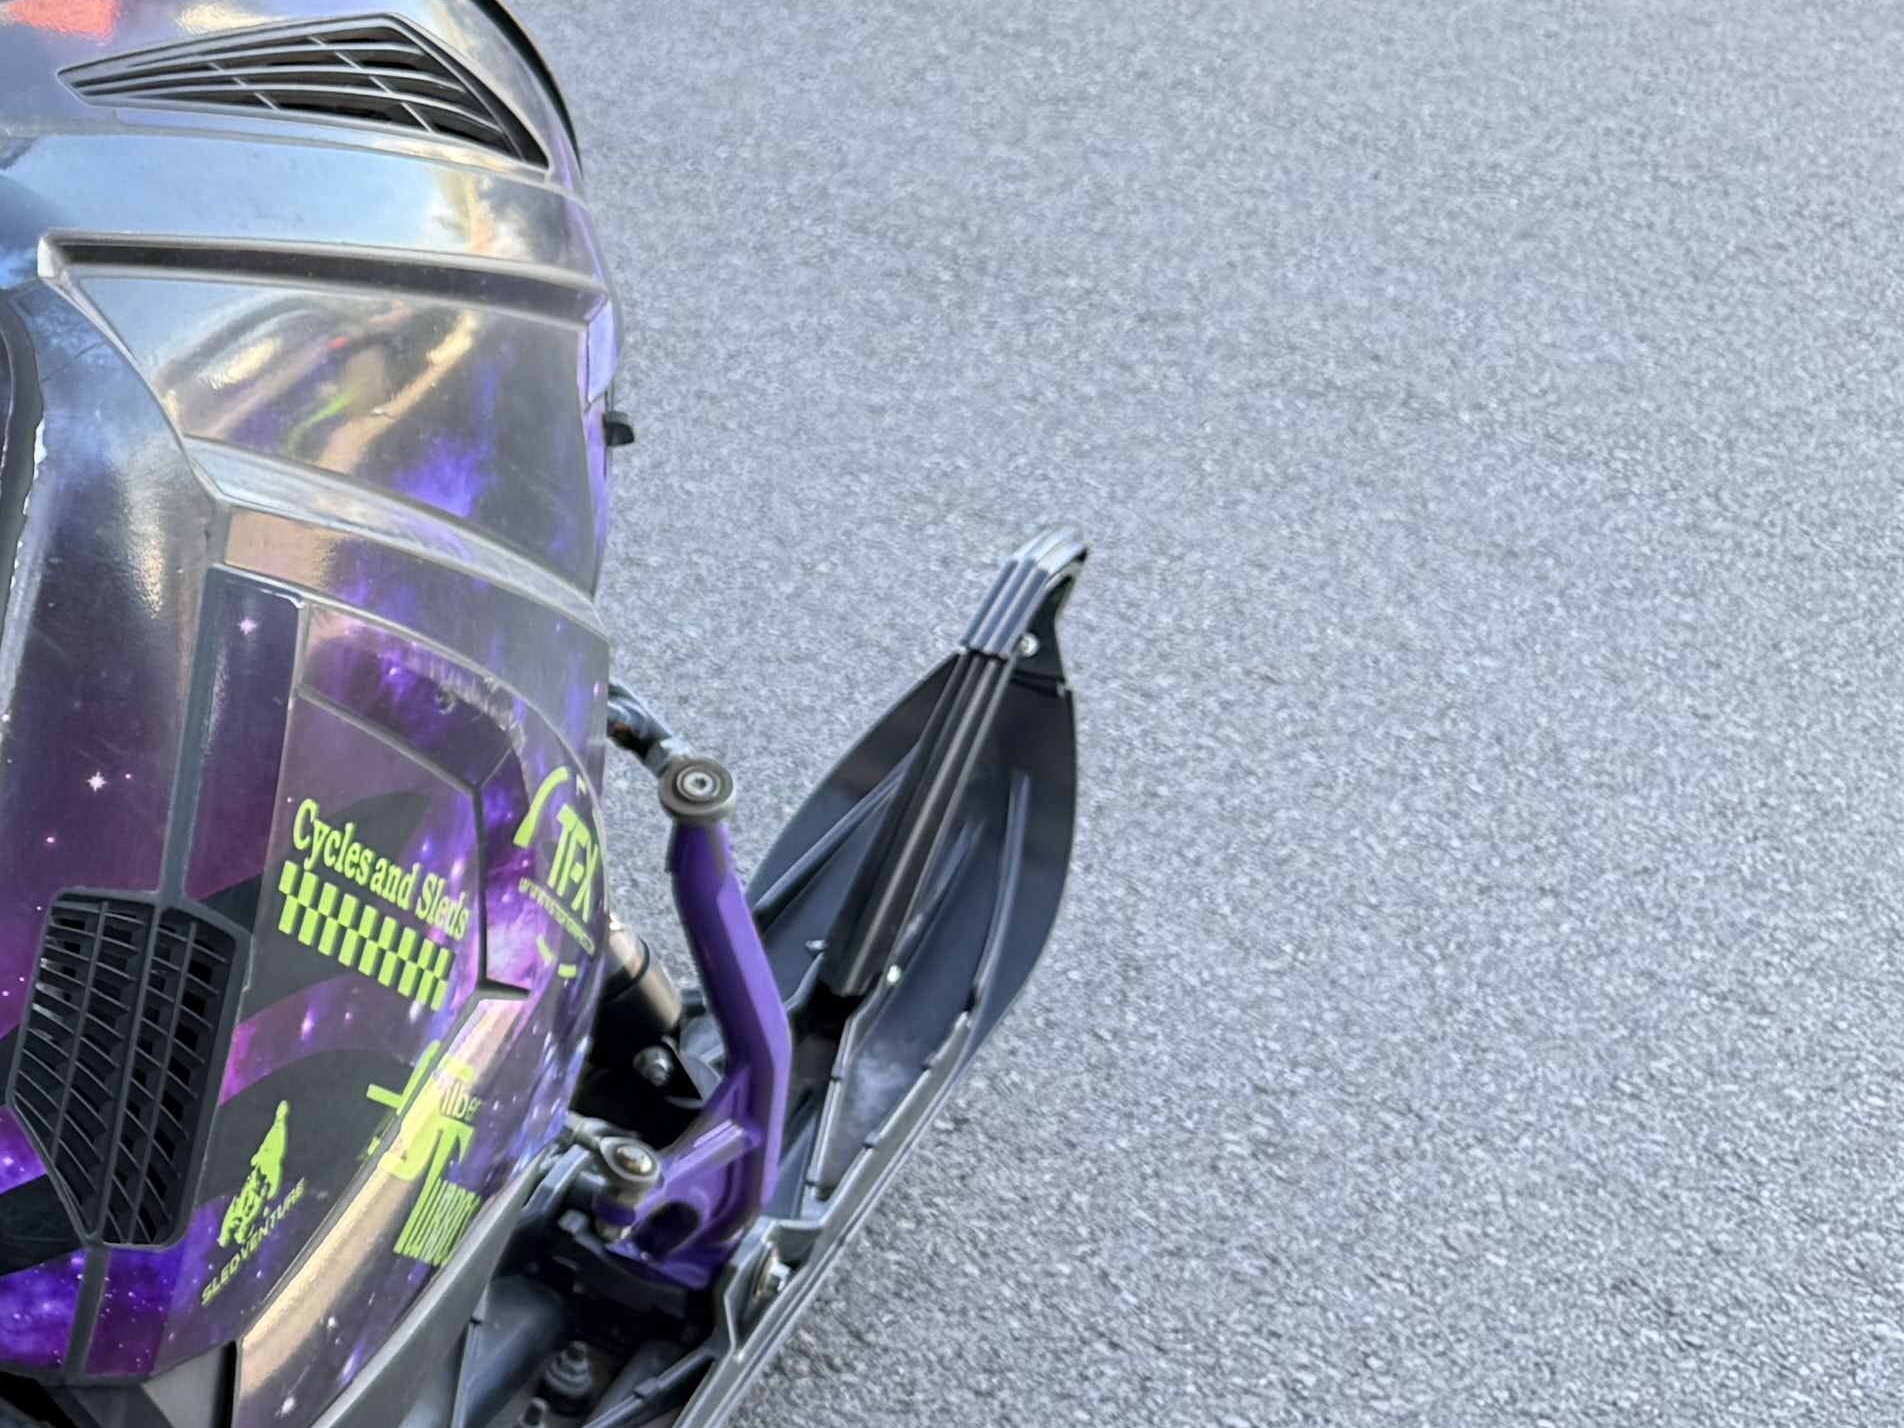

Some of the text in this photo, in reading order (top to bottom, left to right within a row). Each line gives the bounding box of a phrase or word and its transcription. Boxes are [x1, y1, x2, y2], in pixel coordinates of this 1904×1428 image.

[293, 798, 376, 886] Cycles
[369, 857, 422, 911] and
[414, 872, 471, 941] Sleds
[202, 1176, 305, 1308] SLEDVENTURE
